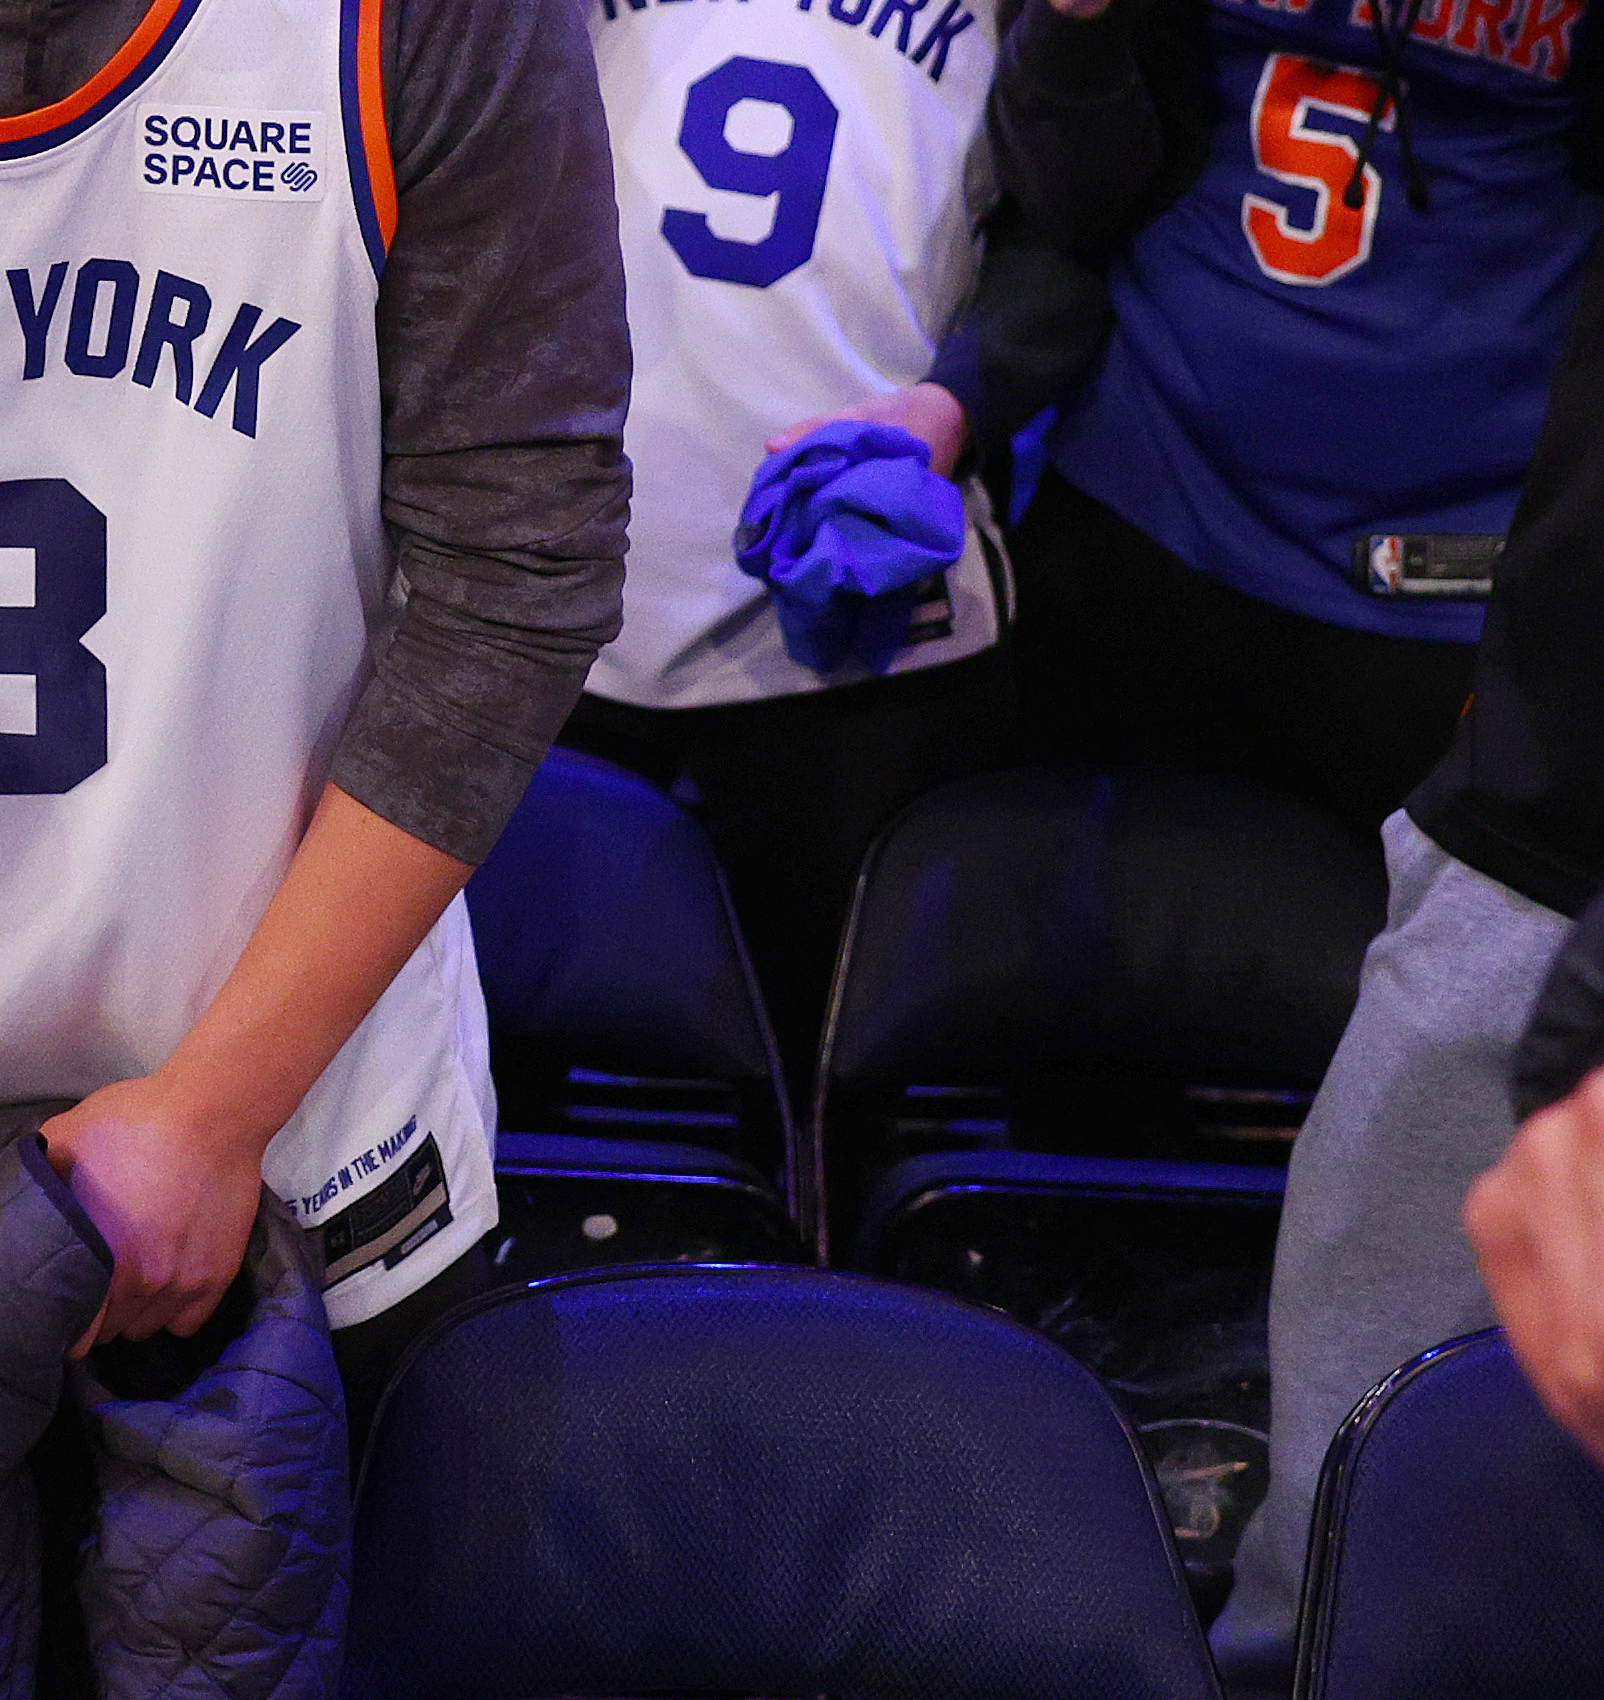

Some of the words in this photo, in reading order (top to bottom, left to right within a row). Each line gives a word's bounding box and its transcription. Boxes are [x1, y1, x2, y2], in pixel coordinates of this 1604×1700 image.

[143, 153, 276, 192] SPACE
[144, 115, 312, 154] SQUARE
[660, 55, 840, 290] 9
[1241, 51, 1408, 289] 5
[5, 257, 303, 440] YORK
[337, 1165, 354, 1190] IN
[350, 1148, 381, 1180] THE
